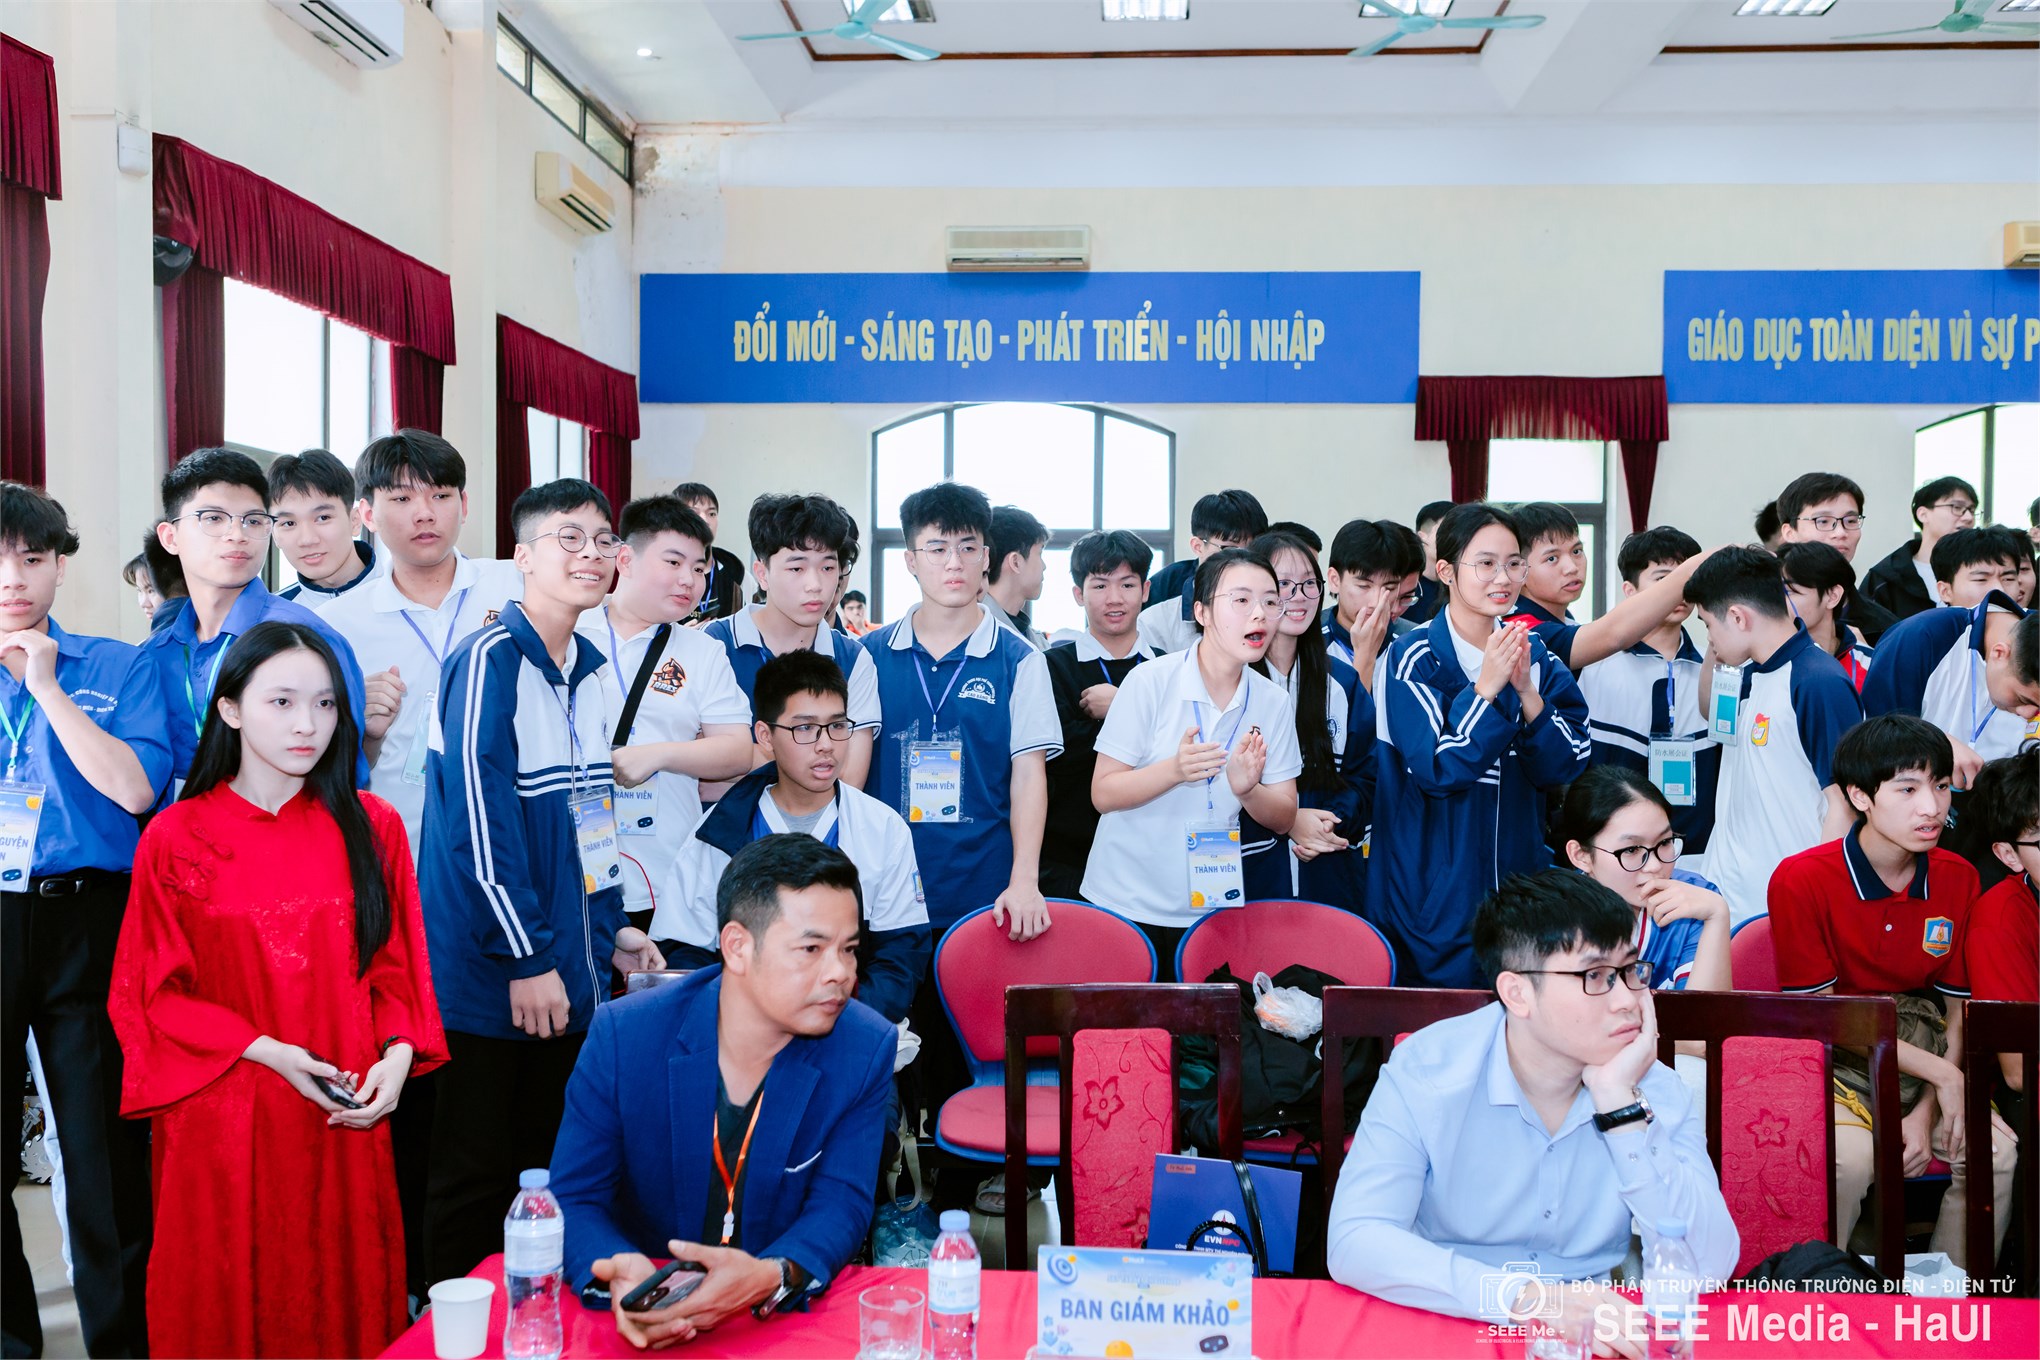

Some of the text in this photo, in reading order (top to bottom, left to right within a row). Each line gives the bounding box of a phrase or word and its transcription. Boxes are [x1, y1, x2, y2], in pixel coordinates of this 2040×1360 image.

[733, 301, 777, 362] ĐỔI
[786, 310, 837, 362] MỚI
[861, 311, 935, 362] SÁNG
[943, 319, 993, 369] TẠO
[1017, 311, 1084, 362] PHÁT
[1092, 300, 1169, 362] TRIỂN
[1196, 309, 1241, 370] HỘI
[1250, 309, 1325, 370] NHẬP
[1687, 309, 1744, 362] GIÁO
[1753, 318, 1802, 370] DỤC
[1809, 309, 1873, 362] TOÀN
[1883, 309, 1940, 369] DIỆN
[1948, 309, 1972, 362] VÌ
[1981, 313, 2018, 370] SỰ
[915, 780, 955, 790] THÀNH VIÊN
[614, 789, 653, 800] HÀNH VIÊN
[0, 836, 29, 850] GUYỆN
[583, 836, 614, 854] THÀNH VIÊN
[1194, 862, 1237, 874] THÀNH VIÊN
[1060, 1295, 1230, 1327] BAN GIÁM KHẢO
